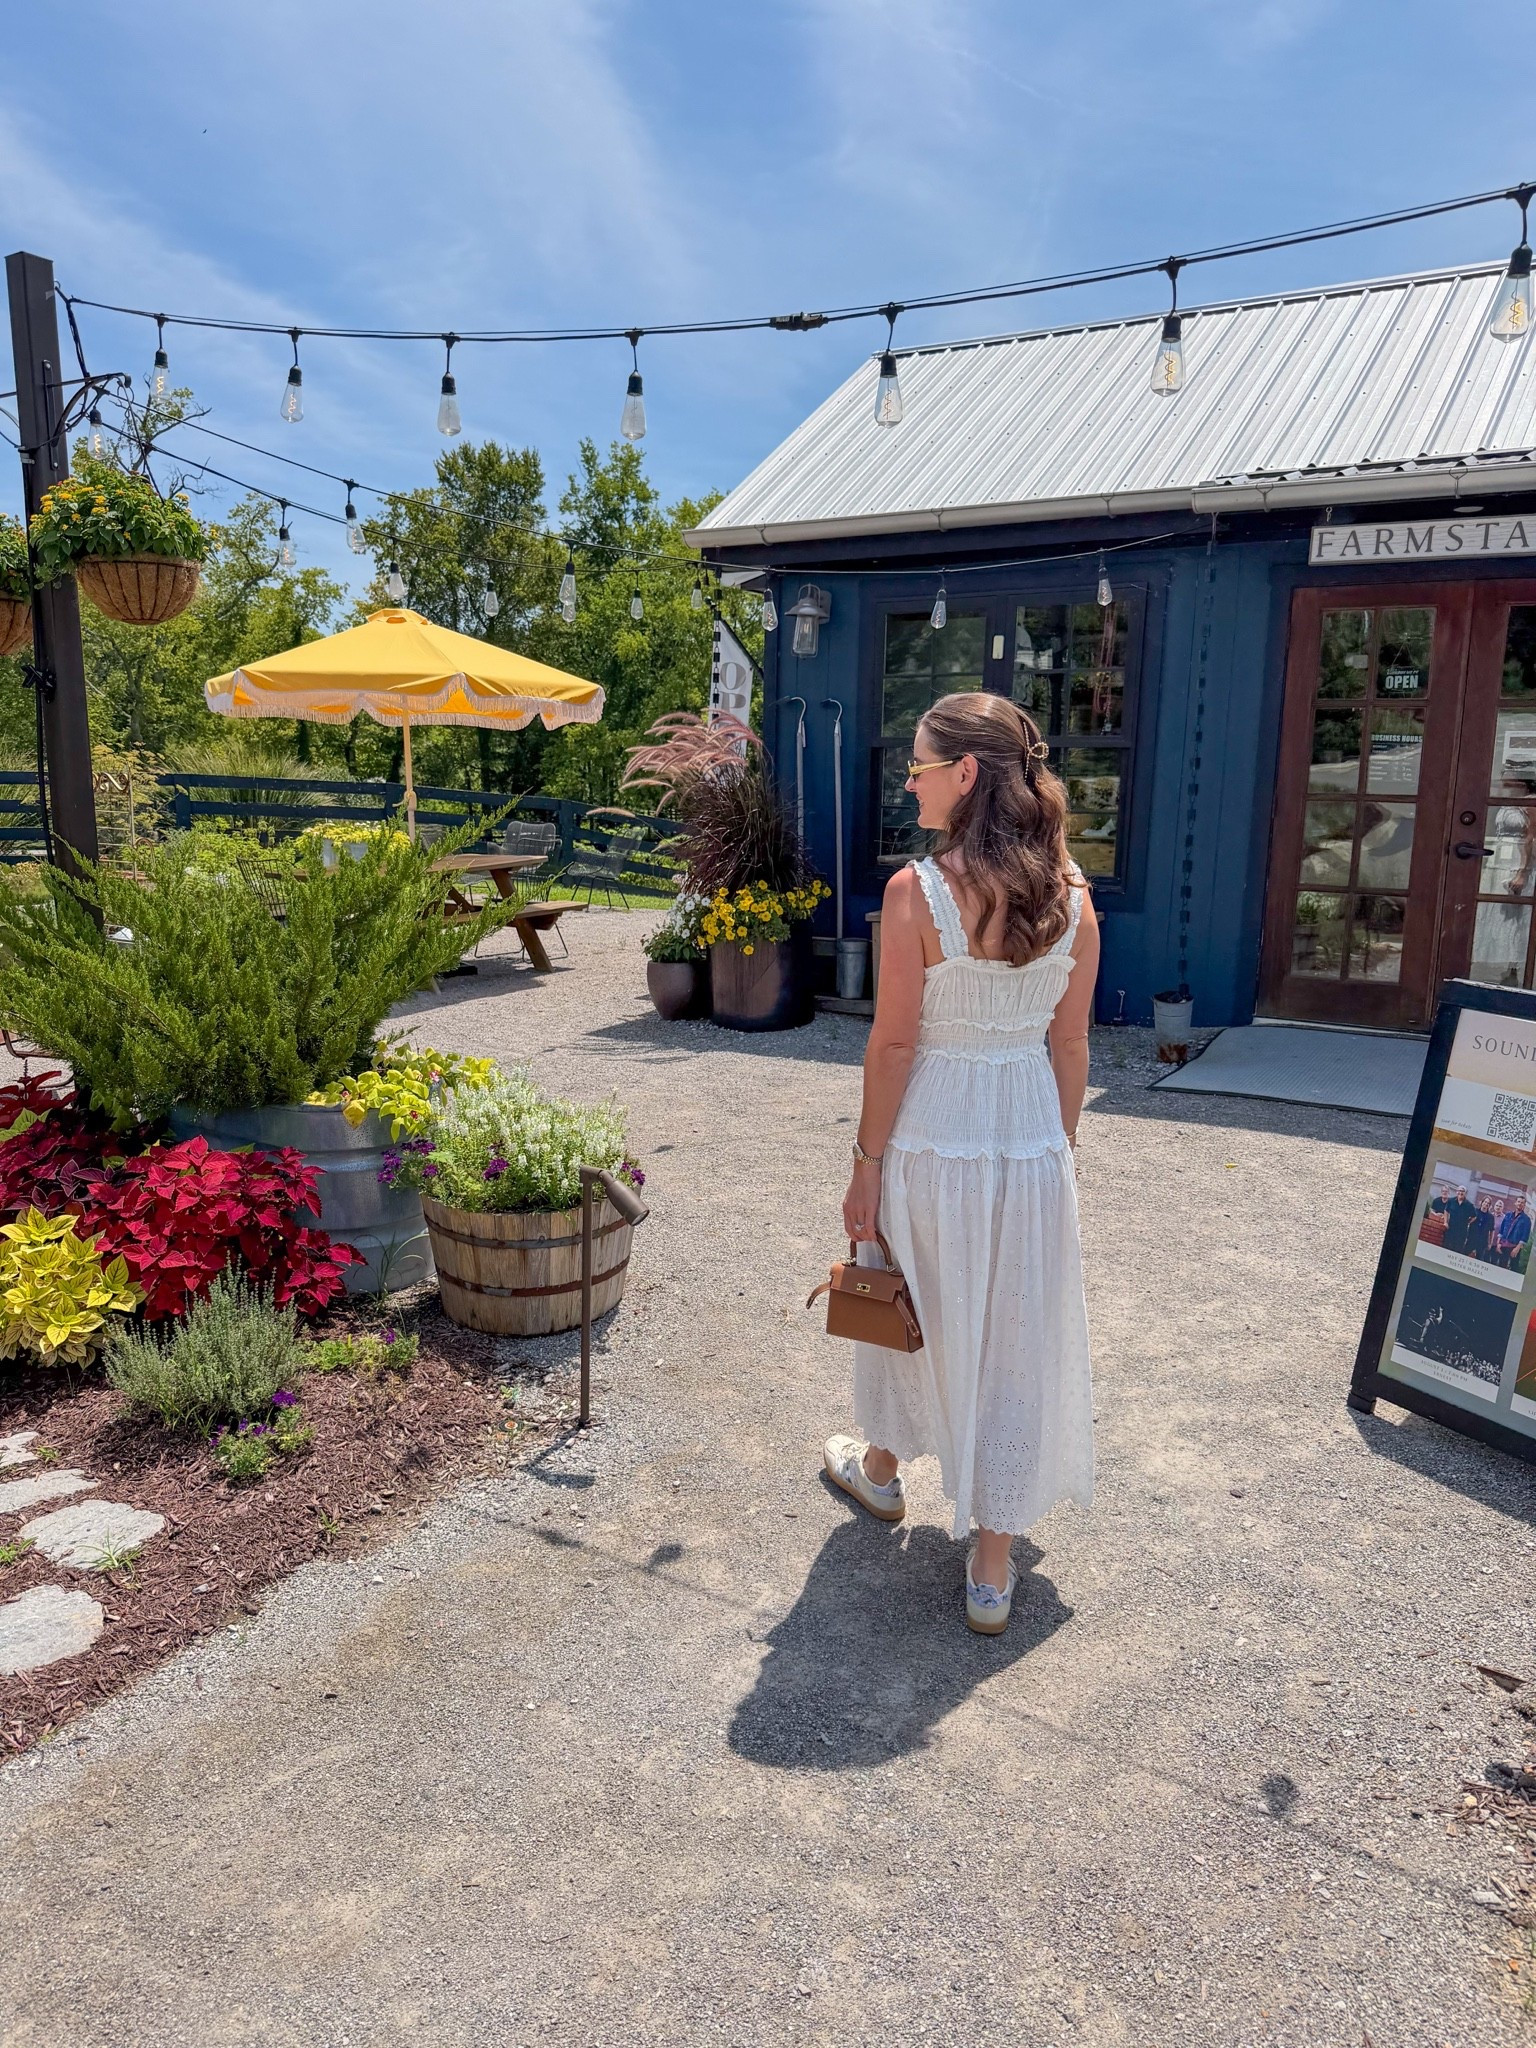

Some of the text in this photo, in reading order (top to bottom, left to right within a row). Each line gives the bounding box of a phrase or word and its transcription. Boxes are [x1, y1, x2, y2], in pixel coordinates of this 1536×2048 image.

[1315, 521, 1530, 558] FARMSTA
[1385, 675, 1419, 690] OPEN
[1371, 734, 1423, 743] BUSINESS HOURS
[1449, 1260, 1483, 1276] SISTER HAZEL
